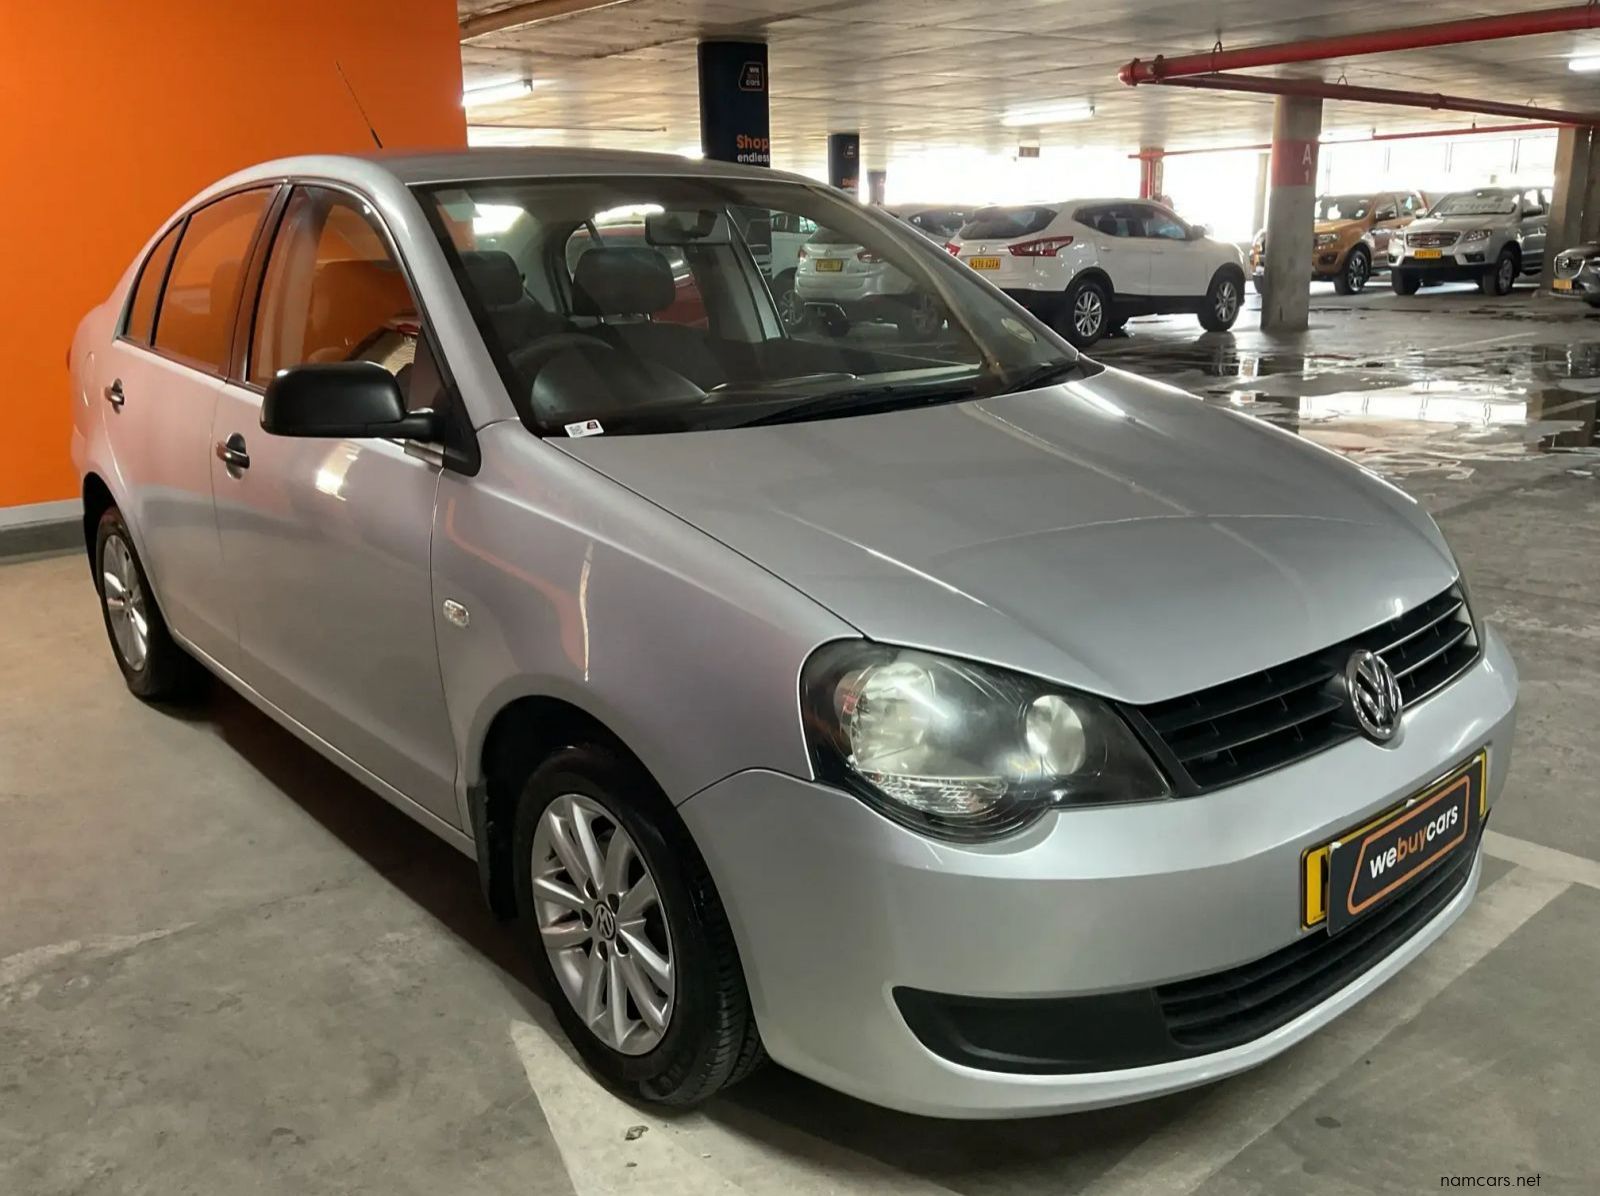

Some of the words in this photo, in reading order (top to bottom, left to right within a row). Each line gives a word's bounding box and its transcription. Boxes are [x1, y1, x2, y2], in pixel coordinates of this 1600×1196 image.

[736, 133, 769, 152] Shop
[1302, 143, 1312, 165] A
[1369, 804, 1458, 879] webuycars
